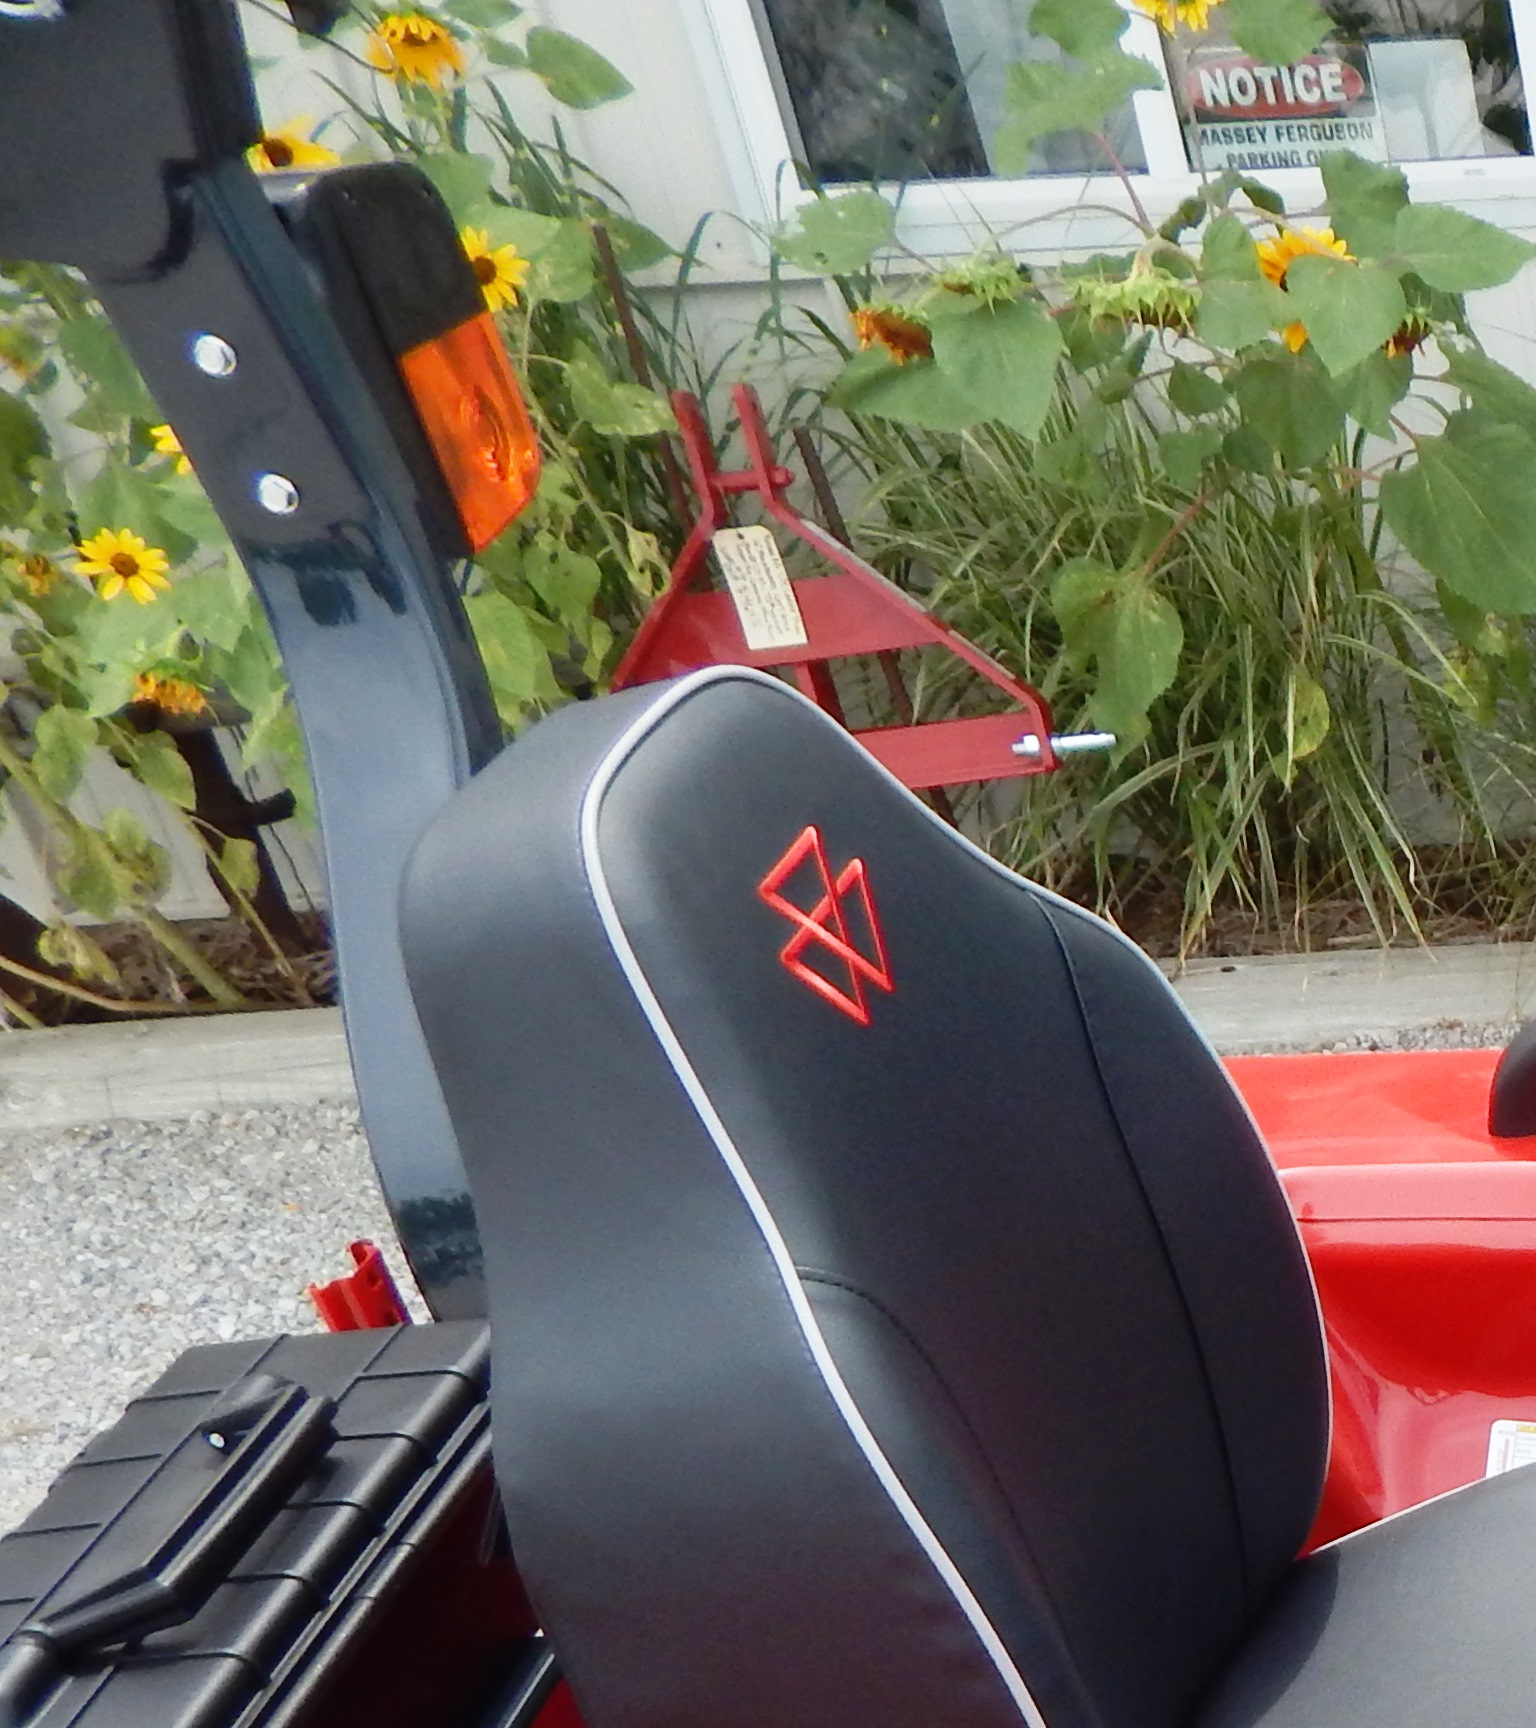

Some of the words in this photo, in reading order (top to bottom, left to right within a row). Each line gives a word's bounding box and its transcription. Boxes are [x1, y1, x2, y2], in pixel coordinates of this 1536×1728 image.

[1198, 62, 1347, 107] NOTICE
[1200, 125, 1267, 146] MASSEY
[1275, 122, 1374, 143] FERGUSON
[1226, 150, 1301, 169] PARKING
